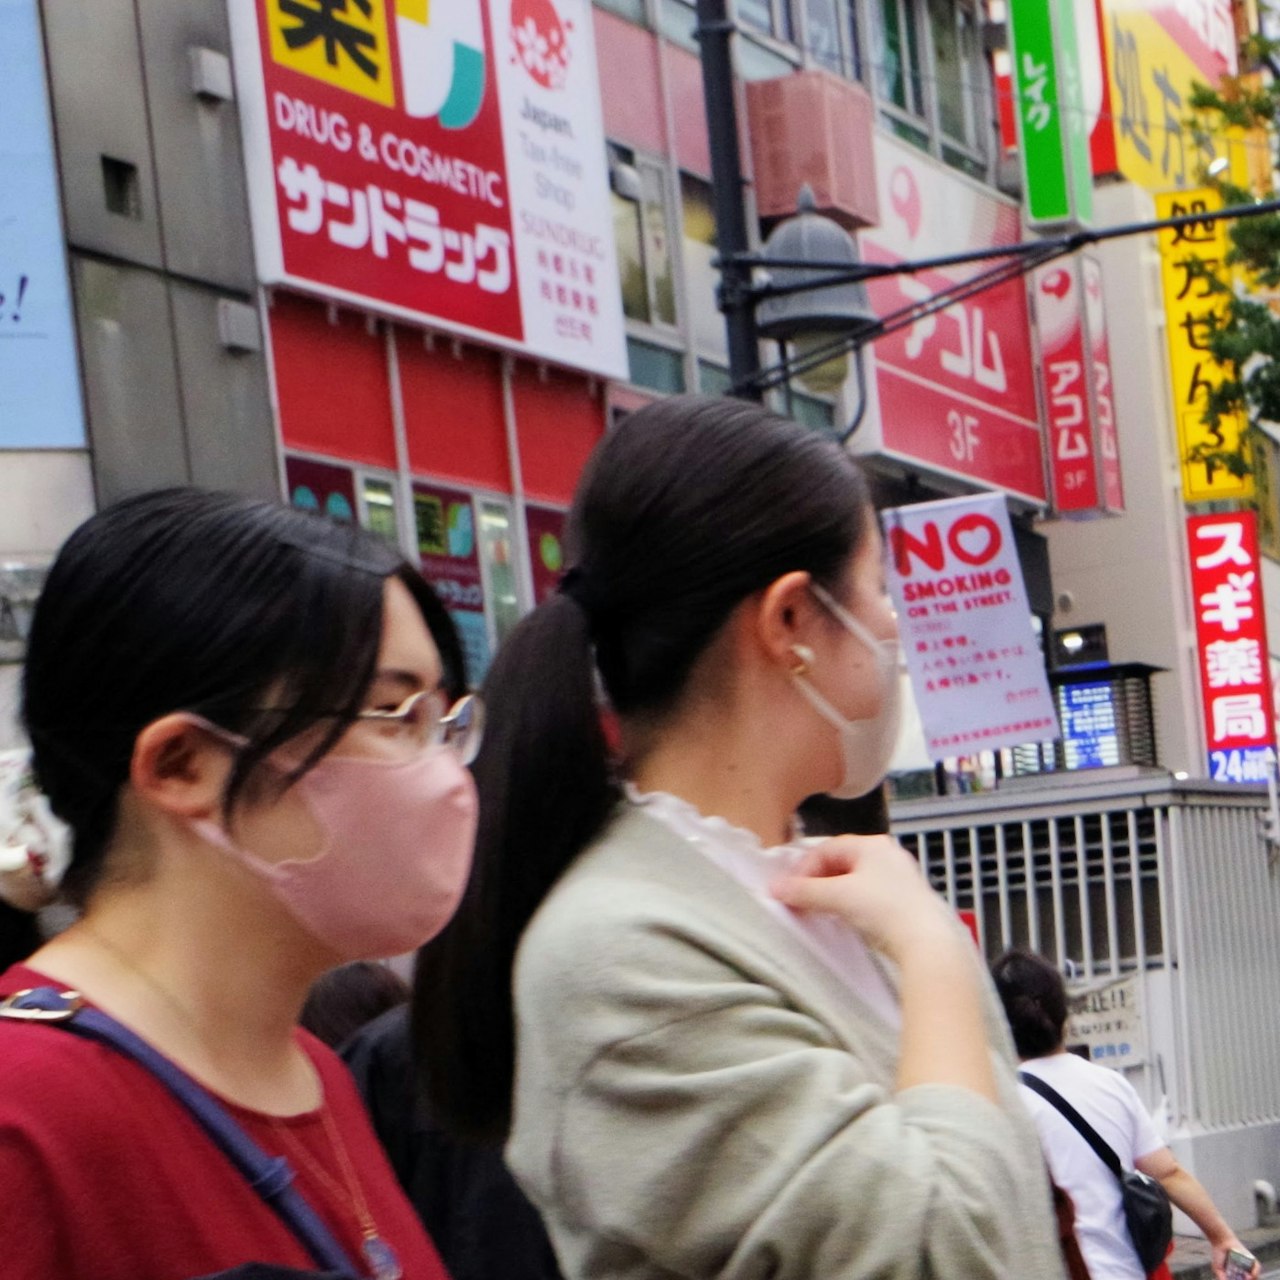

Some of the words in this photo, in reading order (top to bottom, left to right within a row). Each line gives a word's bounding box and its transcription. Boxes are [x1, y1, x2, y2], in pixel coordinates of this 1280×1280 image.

[1022, 52, 1050, 131] レイク
[273, 90, 353, 152] DRUG
[357, 122, 380, 163] &
[380, 131, 504, 208] COSMETIC
[278, 155, 512, 294] サンドラッグ
[899, 273, 1007, 393] アコム
[947, 409, 980, 463] 3F
[1049, 360, 1089, 461] アコム
[1063, 470, 1087, 490] 3F
[889, 512, 1003, 578] NO
[902, 567, 1012, 603] SMOKING
[933, 601, 958, 615] THE
[1195, 521, 1268, 744] スギ薬局
